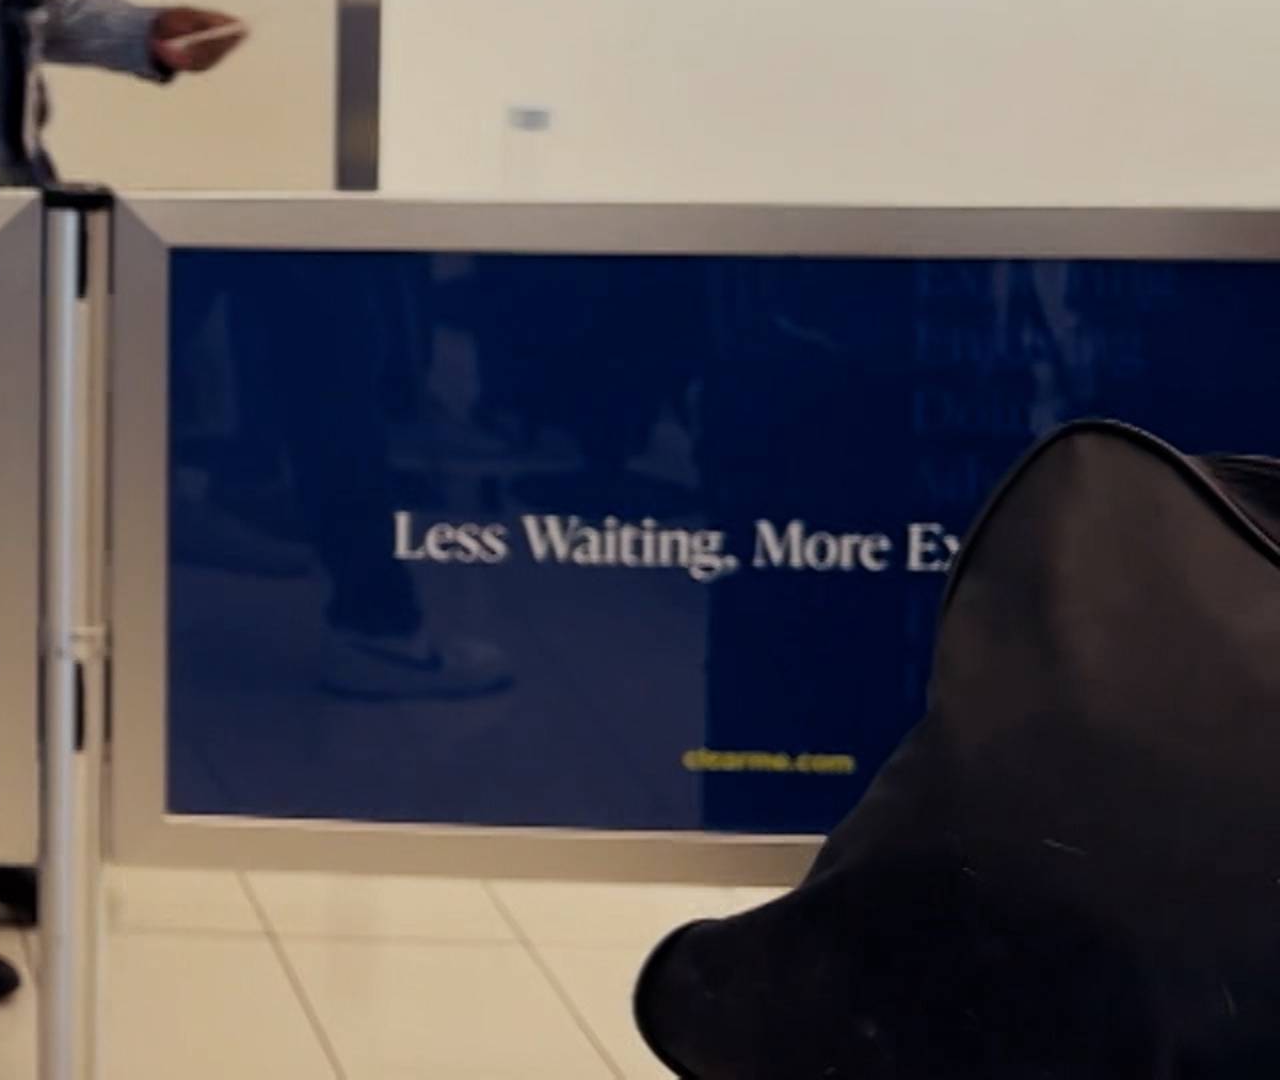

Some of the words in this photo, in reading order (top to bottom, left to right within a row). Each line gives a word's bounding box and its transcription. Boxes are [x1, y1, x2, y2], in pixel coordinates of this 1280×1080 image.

[393, 511, 508, 562] Less
[522, 514, 738, 582] Waiting,
[752, 520, 891, 571] More
